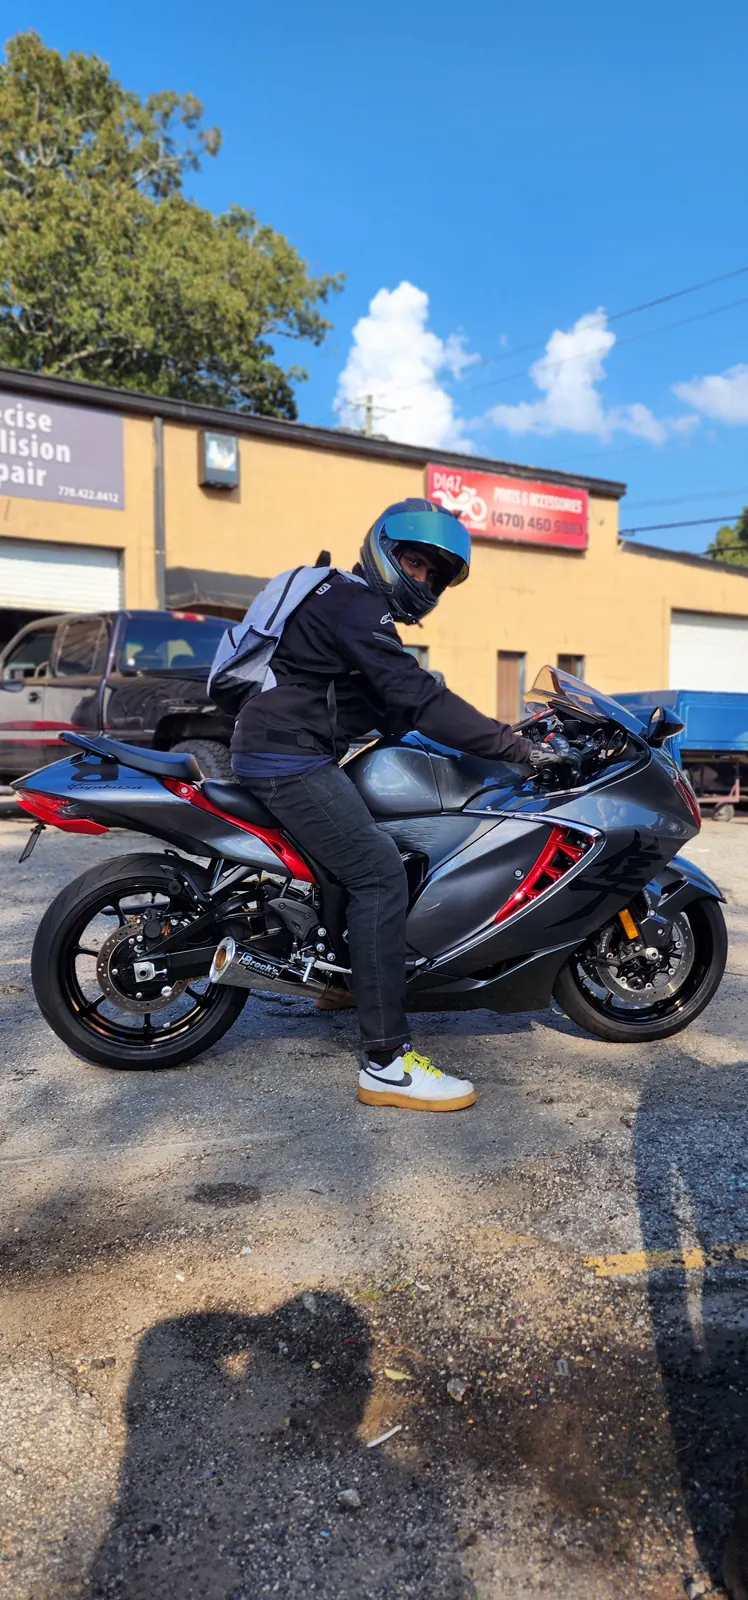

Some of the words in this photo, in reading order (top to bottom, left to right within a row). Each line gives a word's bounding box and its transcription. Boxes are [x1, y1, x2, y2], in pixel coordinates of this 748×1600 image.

[0, 403, 53, 433] cise
[433, 471, 462, 492] DIAZ
[494, 487, 521, 504] PARTS
[529, 491, 582, 513] ACCESSORIES
[491, 510, 525, 531] (470)
[527, 516, 552, 532] 460
[241, 954, 279, 976] Brock's
